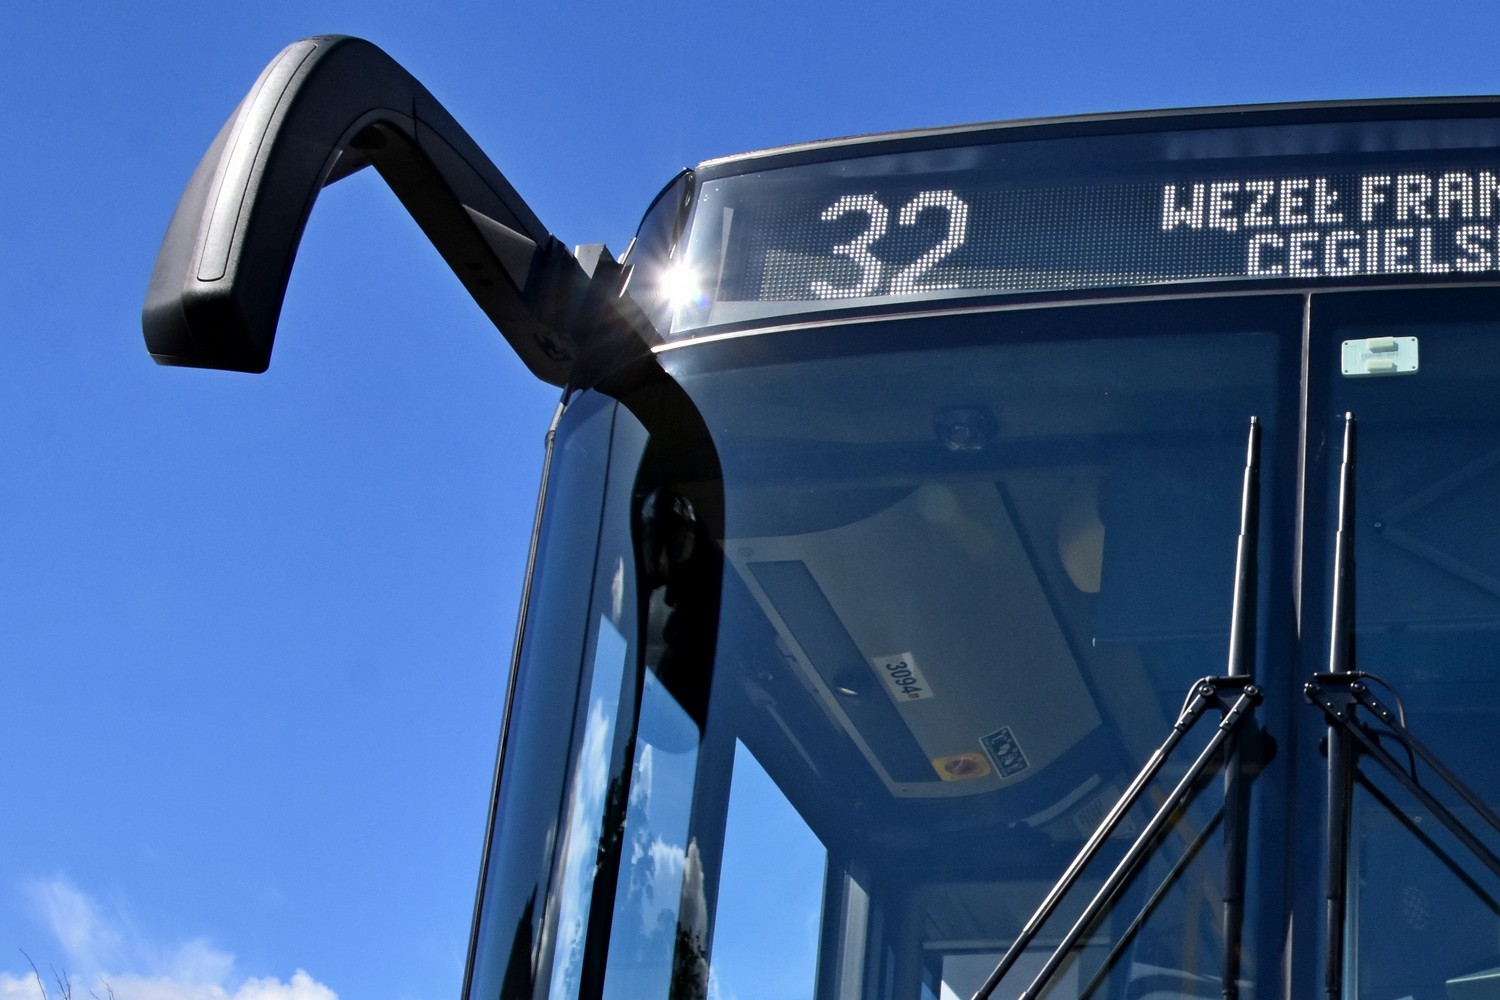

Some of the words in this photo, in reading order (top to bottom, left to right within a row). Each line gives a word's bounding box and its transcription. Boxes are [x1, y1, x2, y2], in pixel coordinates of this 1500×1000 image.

[1162, 178, 1344, 231] WĘZEŁ
[811, 189, 969, 298] 32
[885, 661, 923, 695] 3094
